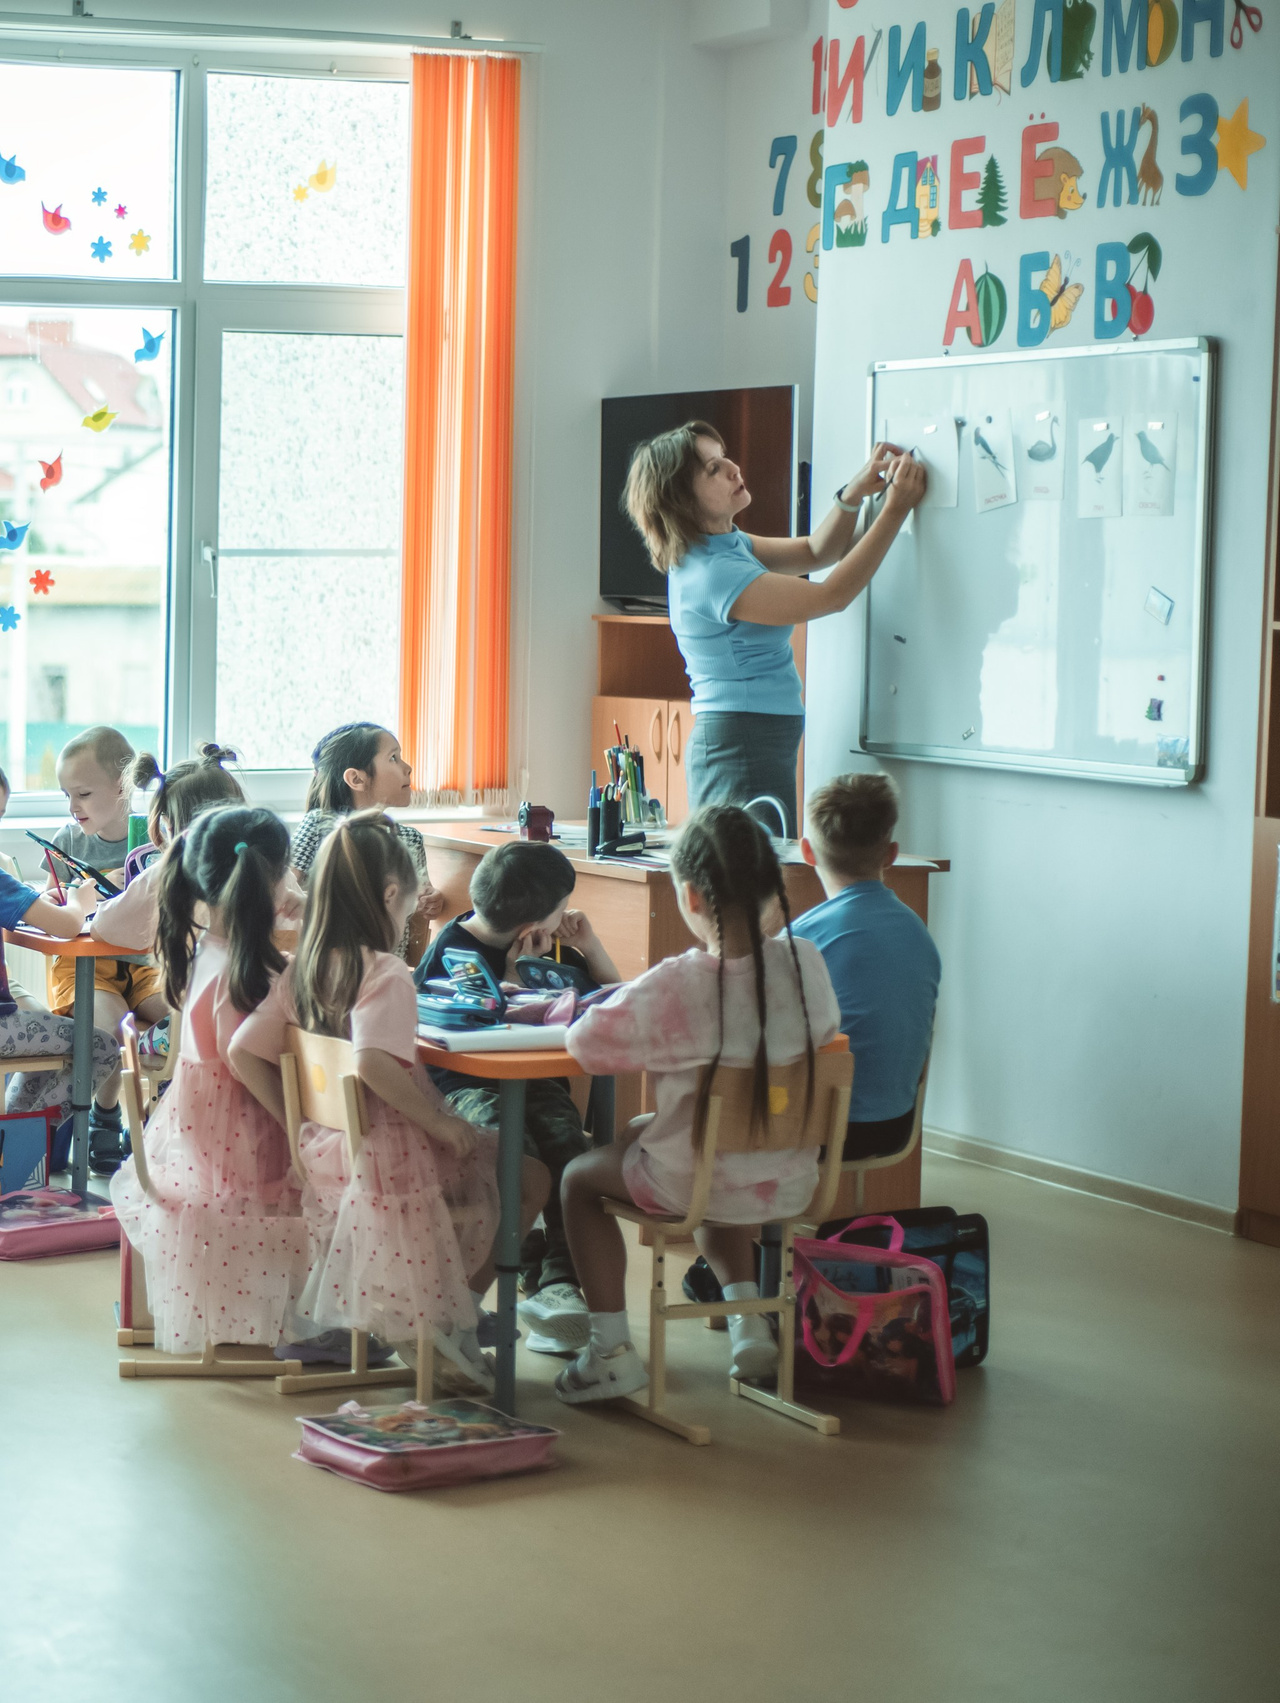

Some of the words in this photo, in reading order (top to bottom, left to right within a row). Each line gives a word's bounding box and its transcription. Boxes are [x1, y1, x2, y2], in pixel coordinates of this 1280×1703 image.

[769, 135, 798, 216] 7
[1097, 106, 1141, 209] Ж
[731, 235, 750, 313] 1
[767, 229, 793, 308] 2
